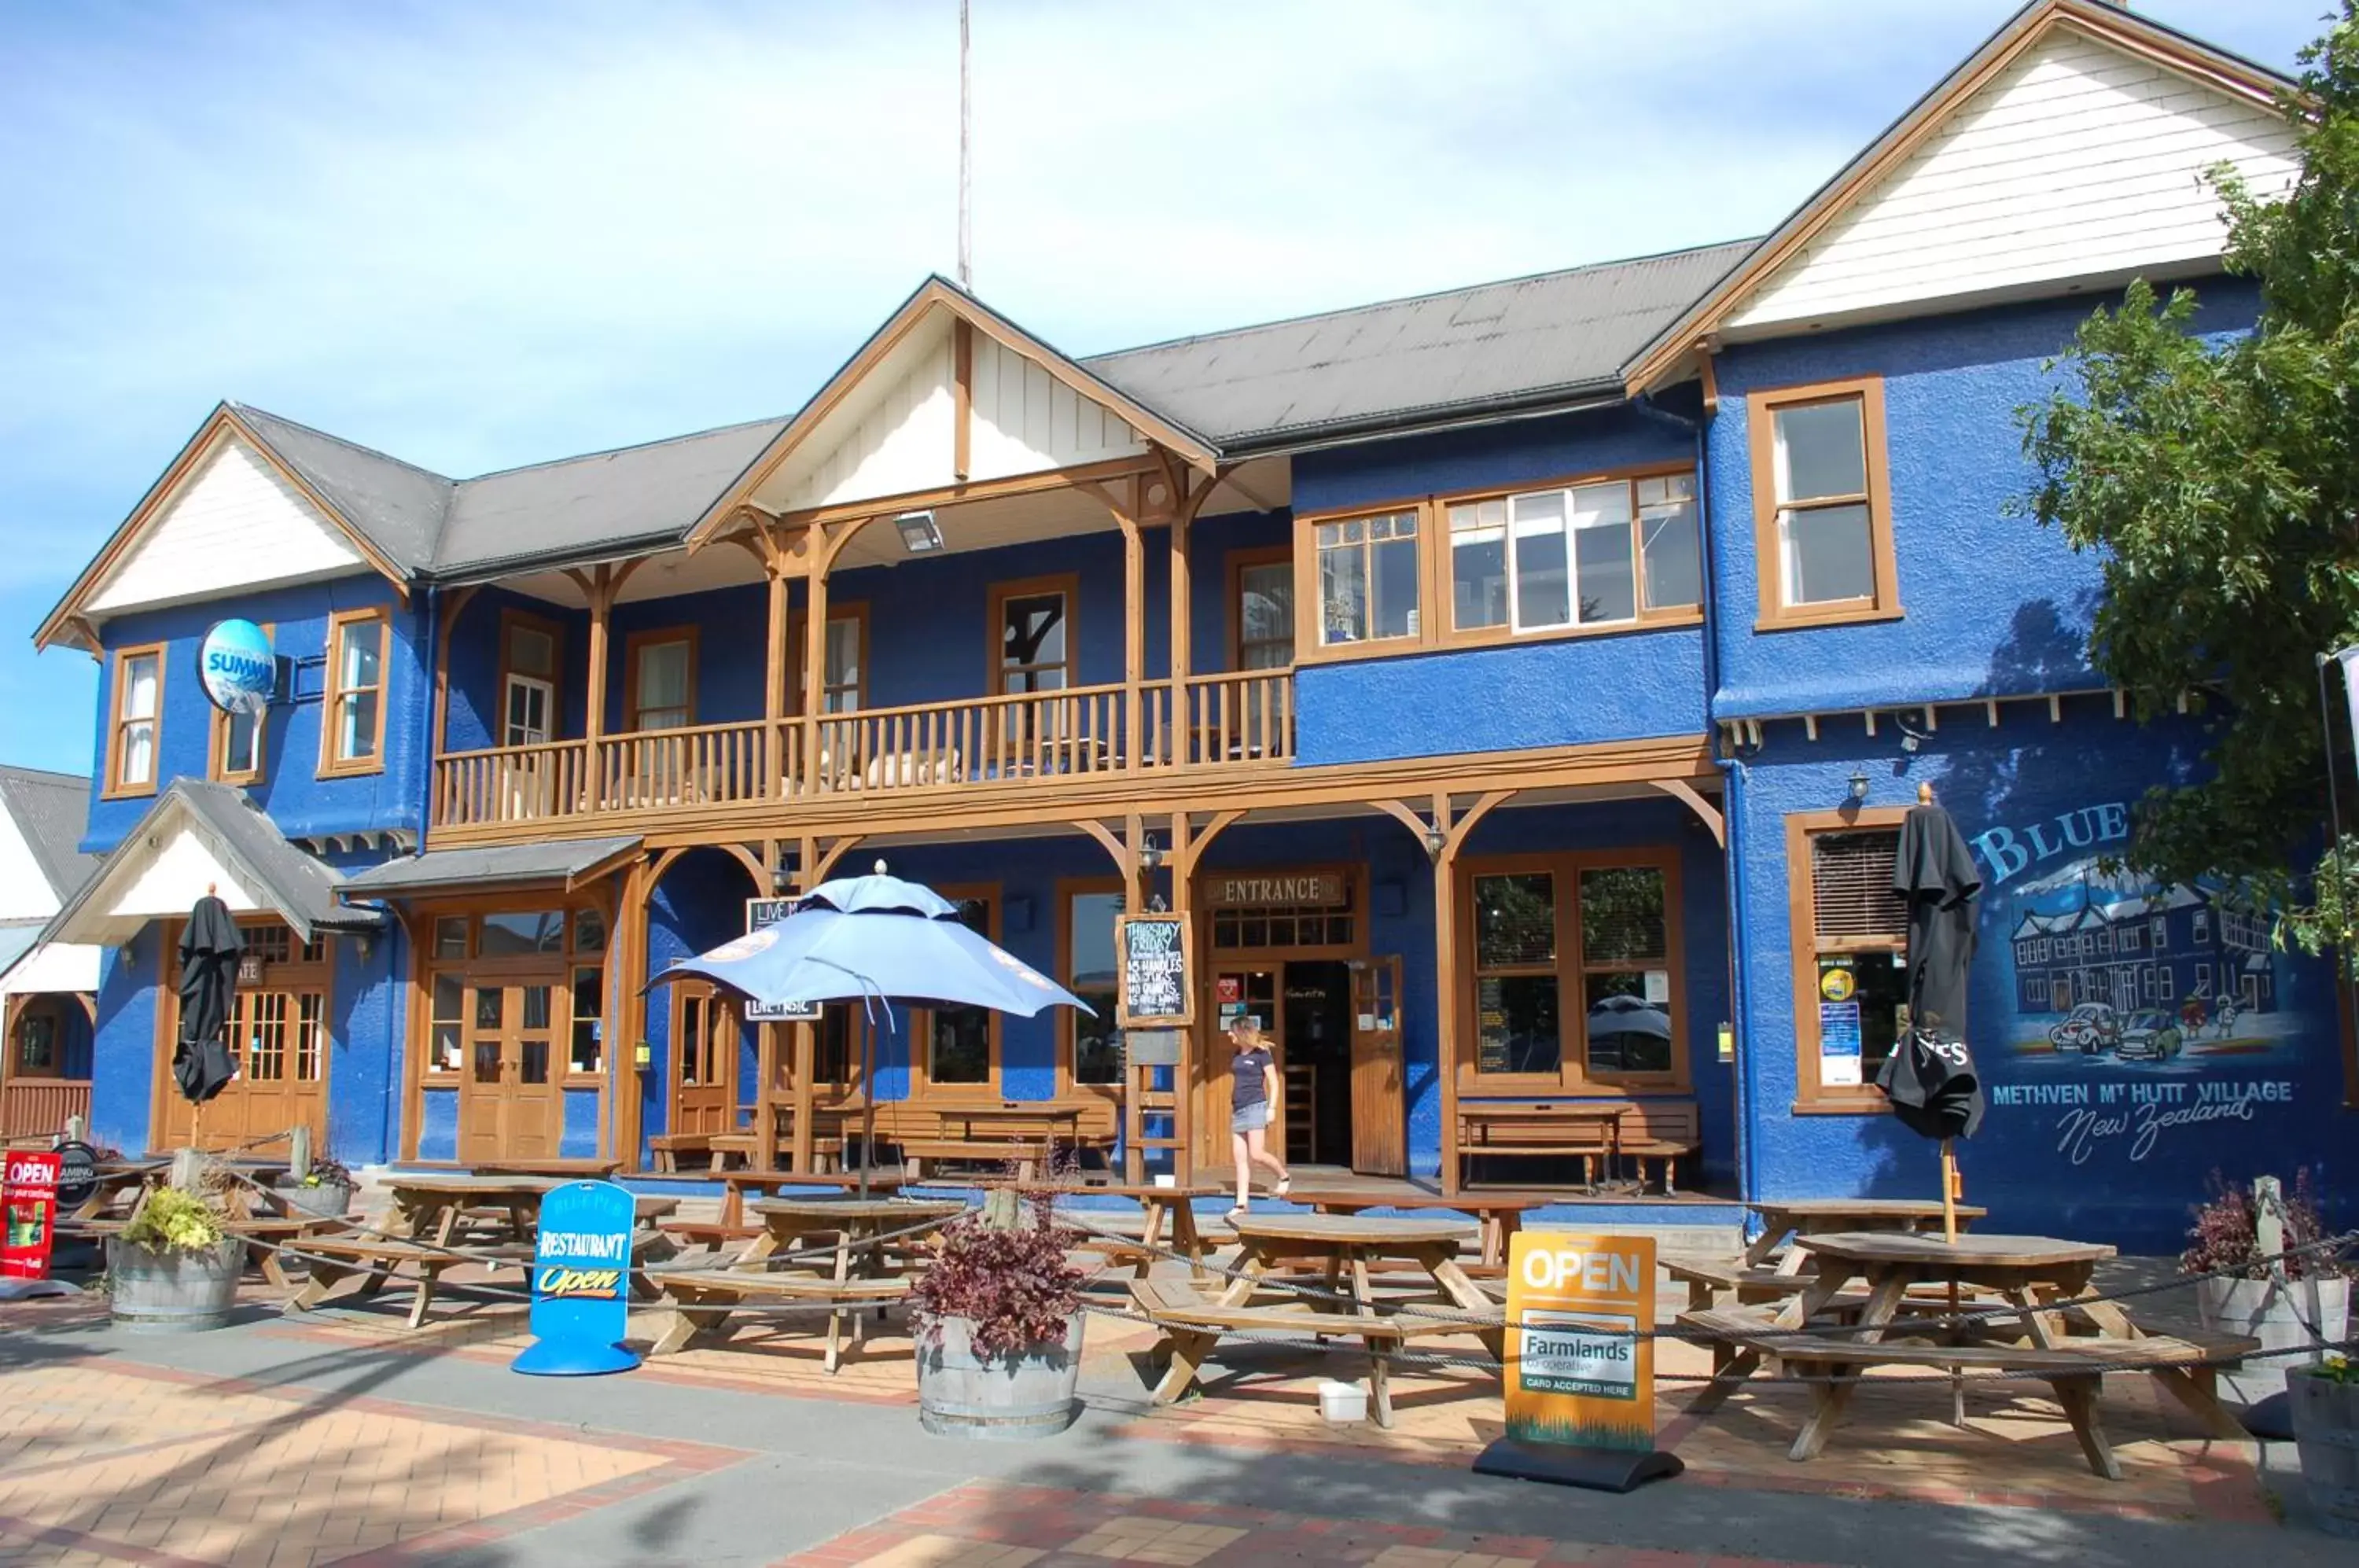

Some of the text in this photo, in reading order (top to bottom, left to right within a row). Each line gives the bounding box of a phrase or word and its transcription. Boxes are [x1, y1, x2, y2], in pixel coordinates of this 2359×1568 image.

[1969, 802, 2128, 885] BLUE
[1225, 878, 1319, 903] ENTRANCE
[757, 903, 786, 920] LIVE
[1132, 937, 1172, 952] FRIDAY
[238, 963, 258, 980] AFE
[1993, 1084, 2089, 1105] METHVEN
[2131, 1083, 2188, 1103] HUTT
[2198, 1081, 2294, 1102] VILLAGE
[2057, 1101, 2254, 1165] New Zealand
[10, 1161, 55, 1185] OPEN
[61, 1167, 94, 1177] AMING
[539, 1231, 627, 1261] RESTAURANT
[539, 1265, 621, 1295] Open
[1522, 1248, 1640, 1294] OPEN
[1527, 1336, 1628, 1361] Farmlands
[1526, 1378, 1629, 1397] CARD ACCEPTED HERE
